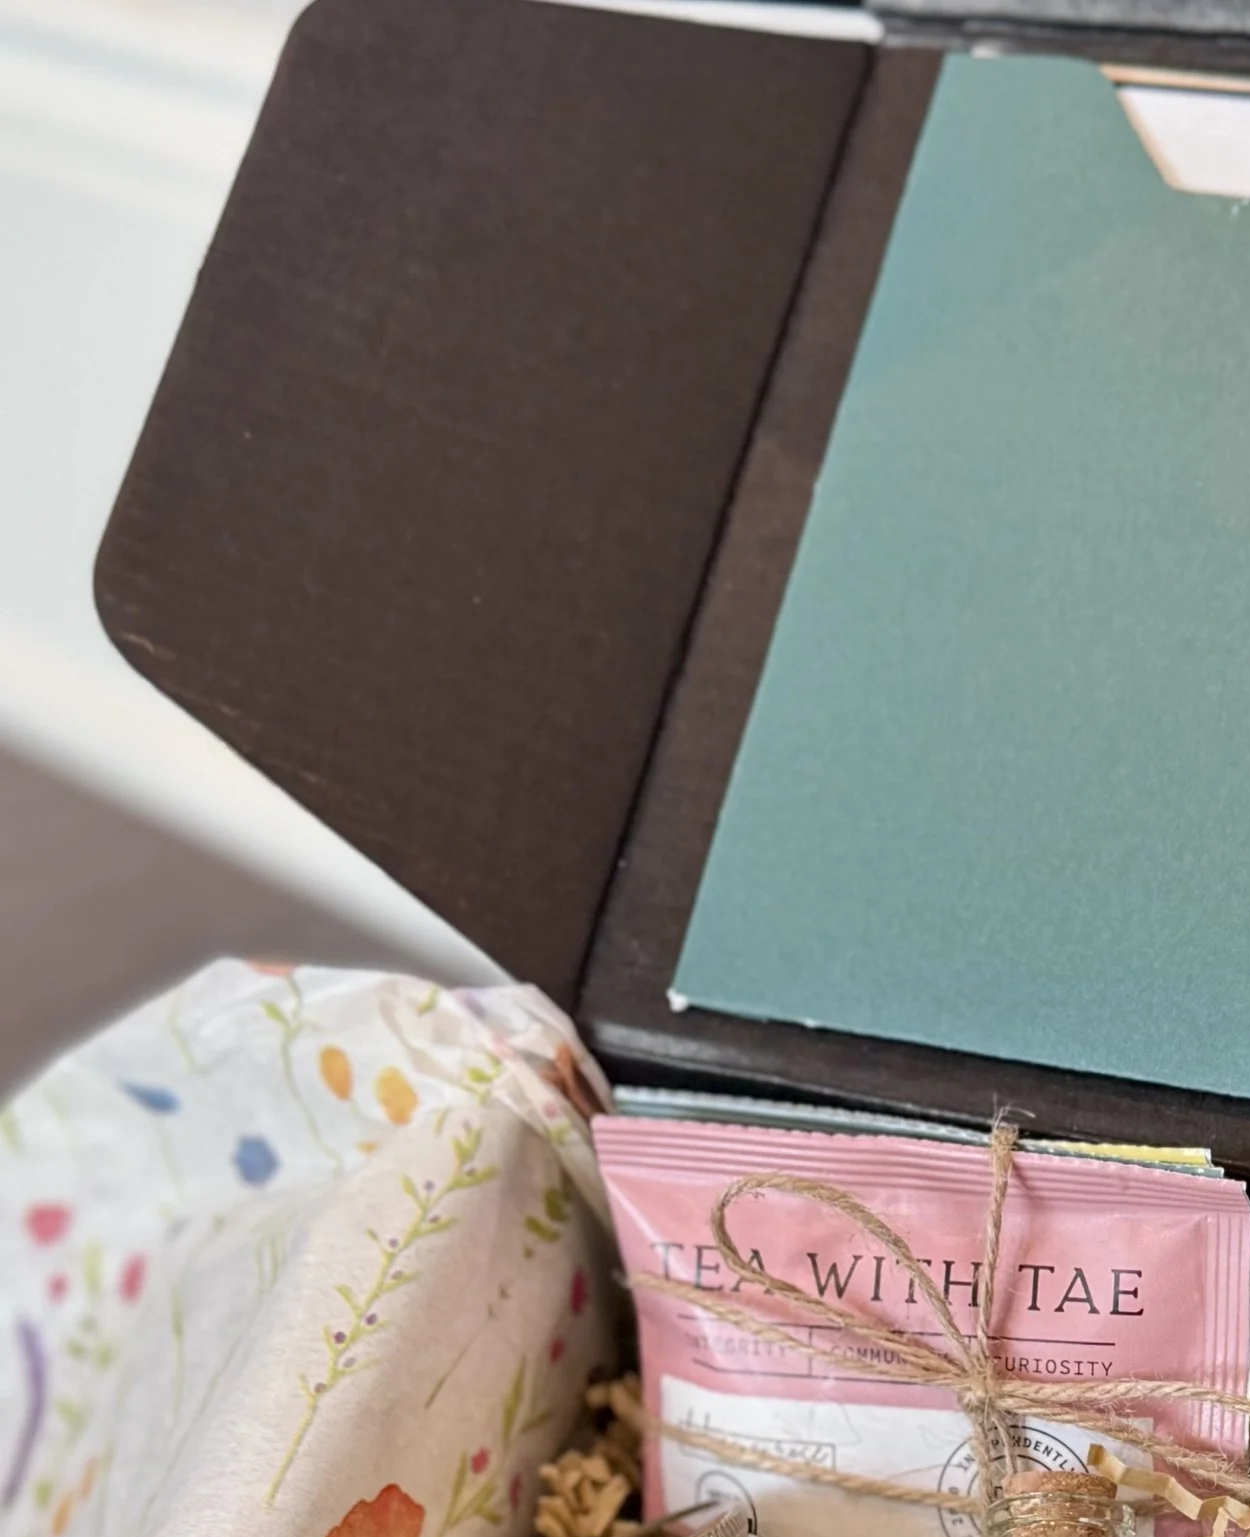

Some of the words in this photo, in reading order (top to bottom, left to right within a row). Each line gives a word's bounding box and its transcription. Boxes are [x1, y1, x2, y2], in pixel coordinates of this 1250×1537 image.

[651, 1242, 774, 1295] TEA
[806, 1252, 984, 1307] WITH
[1018, 1263, 1145, 1317] TAE
